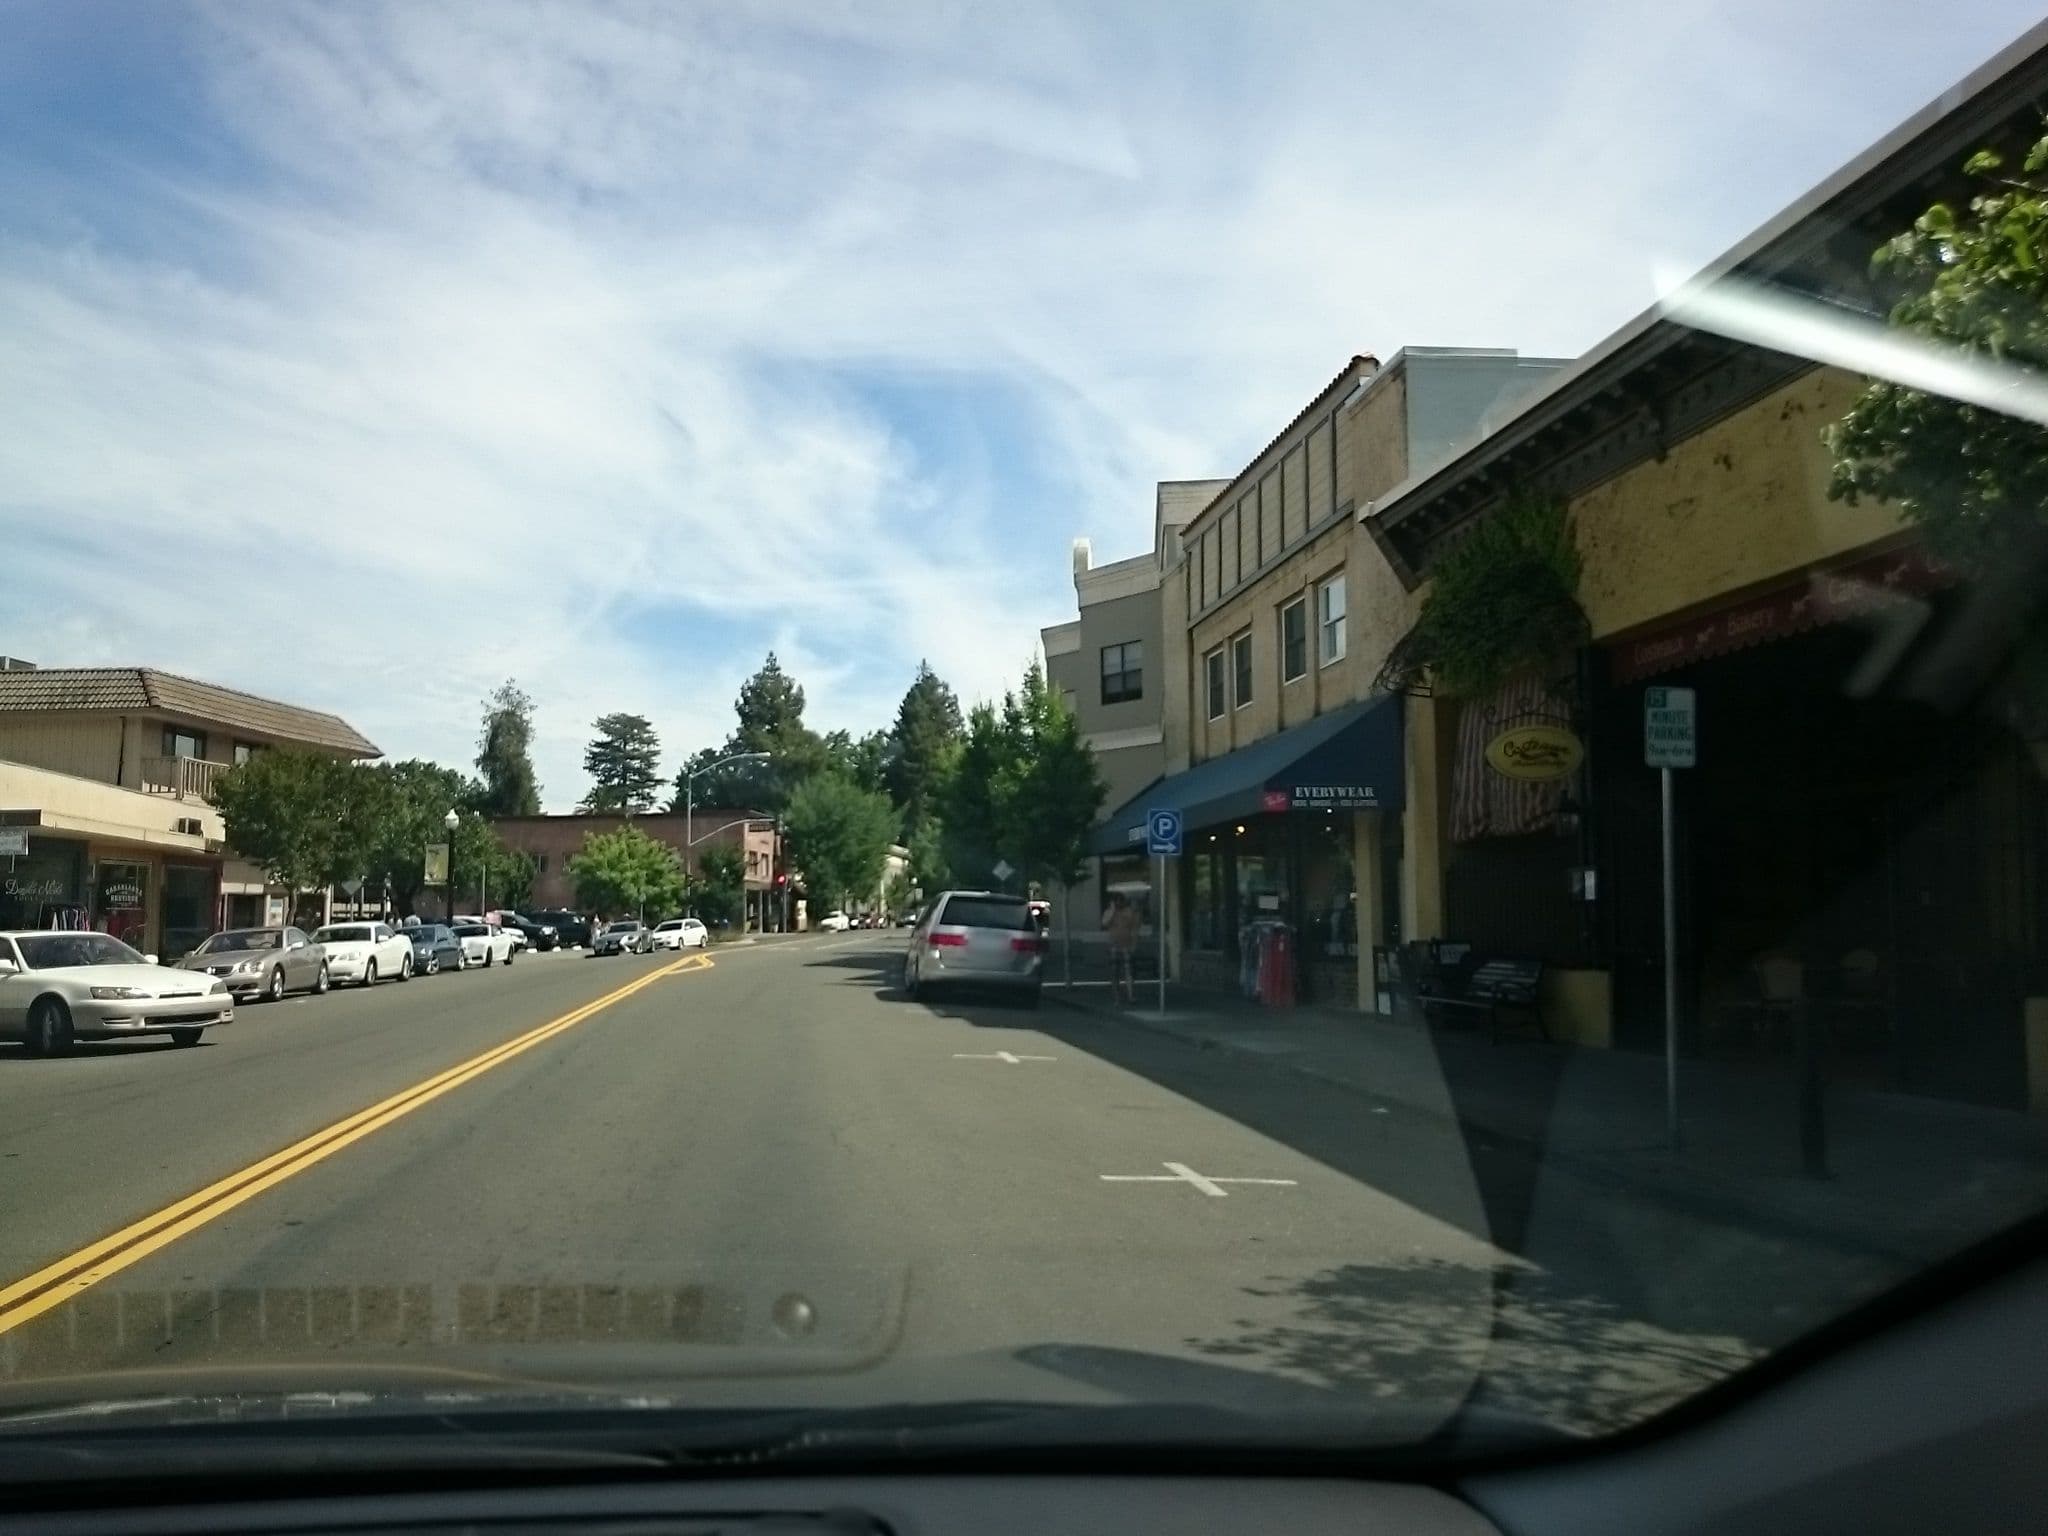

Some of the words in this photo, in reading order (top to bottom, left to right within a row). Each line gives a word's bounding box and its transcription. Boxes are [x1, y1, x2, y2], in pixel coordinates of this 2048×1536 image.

[1651, 711, 1689, 724] MINUTE
[1648, 727, 1691, 740] PARKING
[1295, 786, 1376, 798] EVERYWEAR
[1158, 817, 1173, 836] P
